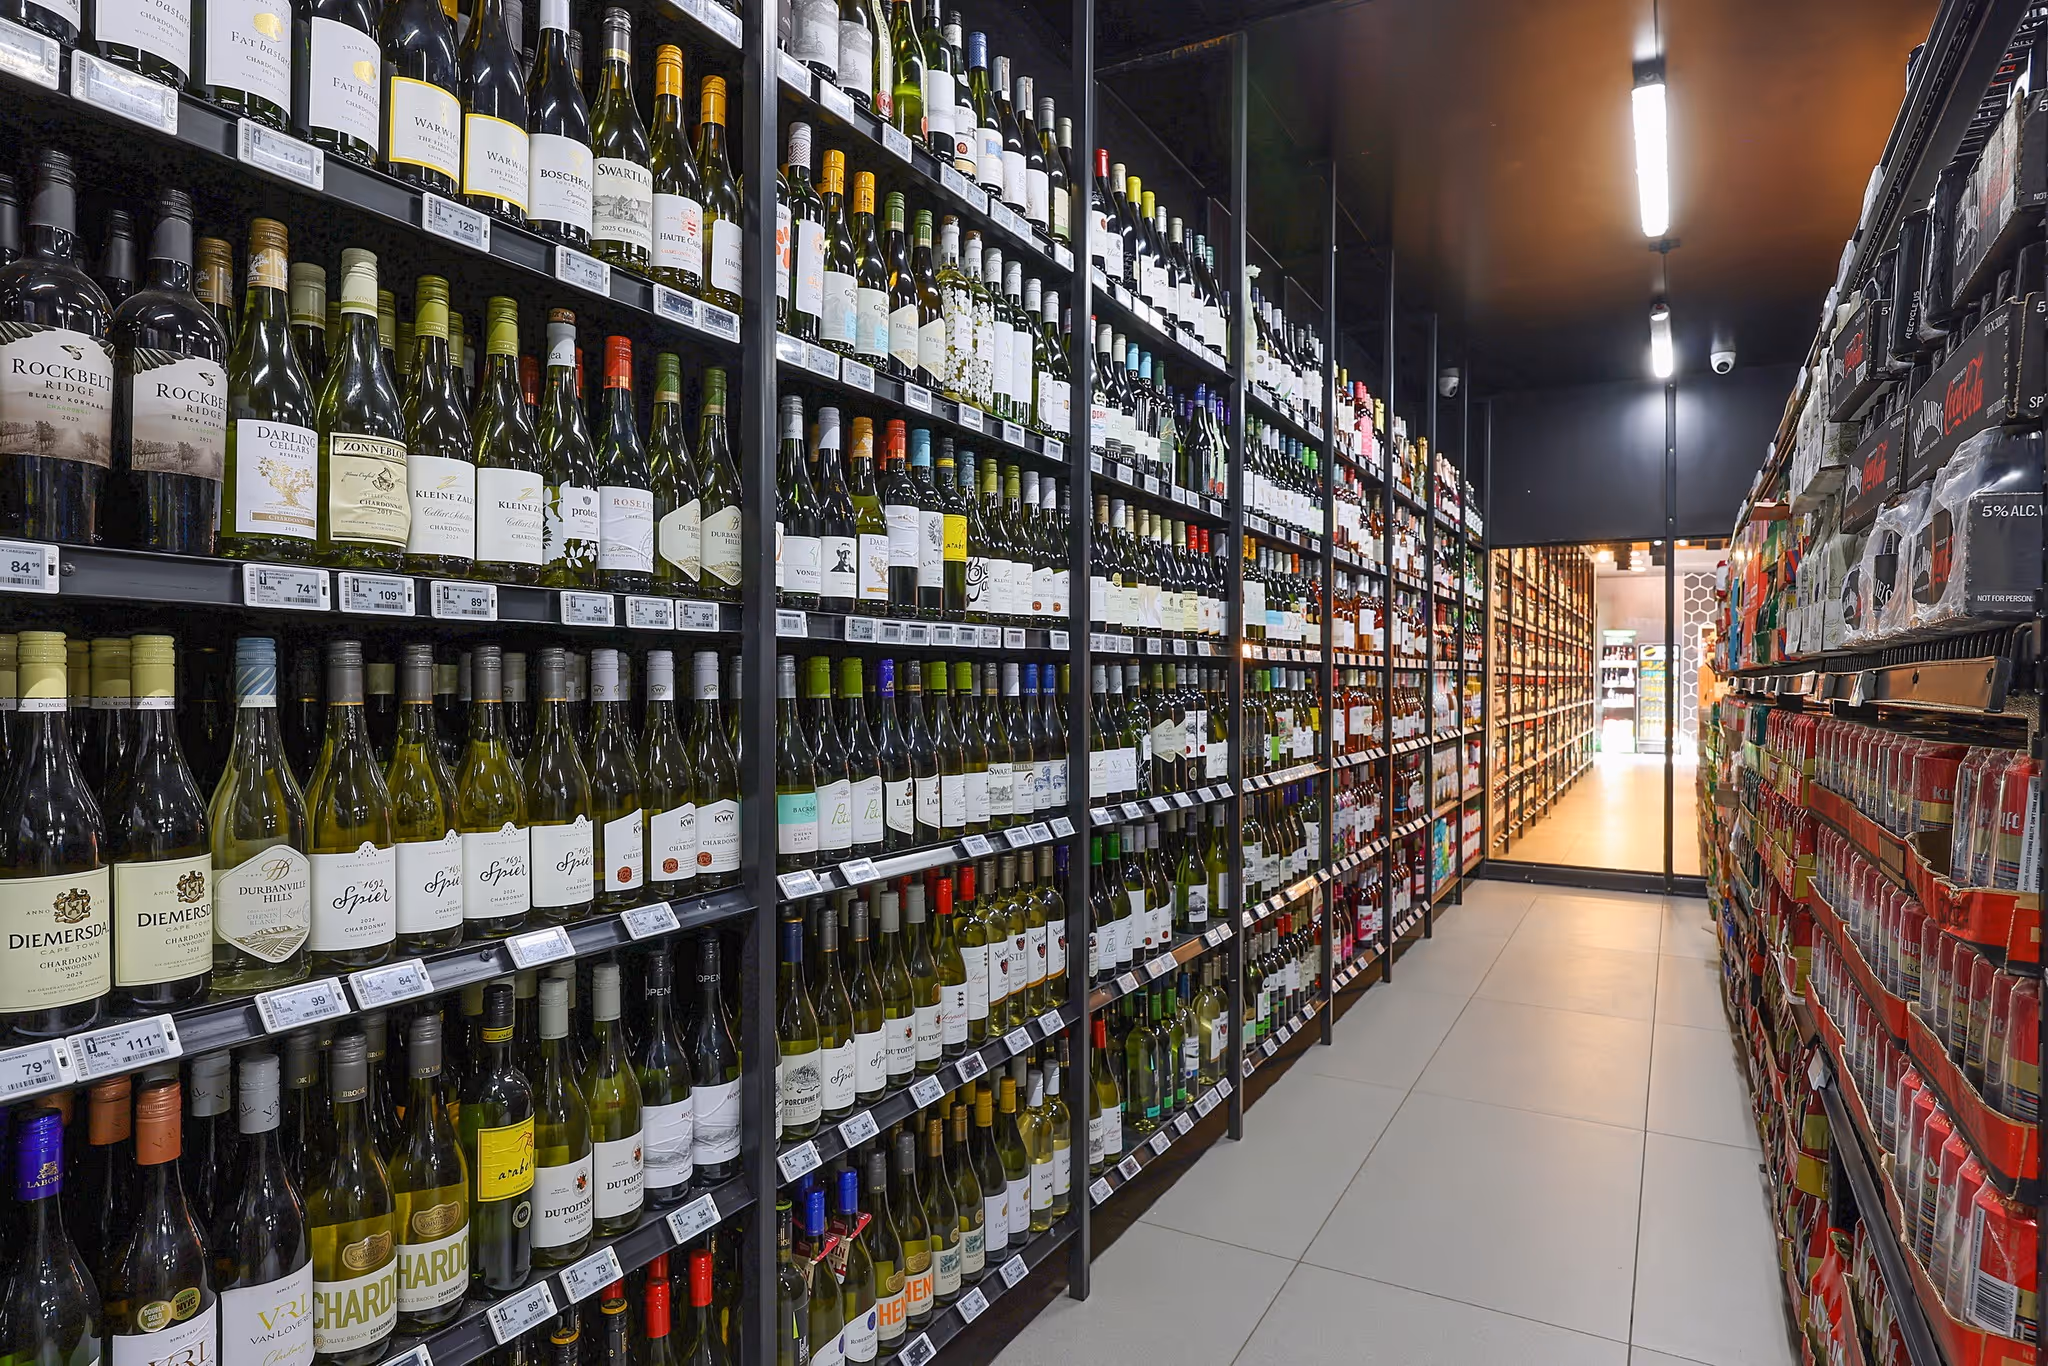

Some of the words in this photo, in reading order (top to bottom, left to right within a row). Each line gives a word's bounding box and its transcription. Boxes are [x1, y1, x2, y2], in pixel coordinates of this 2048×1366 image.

[231, 30, 256, 47] FAT
[332, 77, 355, 92] FAT
[660, 233, 686, 244] HAUTE
[1905, 302, 1919, 340] RECYCLE
[1912, 291, 1920, 302] US
[12, 358, 111, 392] ROCKBELT
[45, 380, 94, 397] RIDGE
[28, 392, 62, 401] BLACK
[186, 404, 222, 421] RIDGE
[171, 414, 200, 424] BLACK
[257, 426, 316, 449] DARLING
[269, 440, 310, 455] CELLARS
[415, 490, 455, 501] KLEINE
[498, 501, 532, 512] KLEINE
[1982, 506, 2008, 517] 5%
[2011, 505, 2037, 517] ALC.
[571, 507, 598, 519] protea
[714, 814, 734, 823] KWV
[480, 860, 527, 886] Spier
[239, 880, 306, 896] DURBANVILLE
[362, 879, 384, 892] 1692
[263, 892, 292, 903] HILLS
[332, 886, 392, 914] Spier
[25, 908, 50, 916] ANNO
[247, 913, 279, 921] CHENIN
[166, 925, 190, 933] CAPE
[345, 922, 387, 933] CHARDONNAY
[40, 947, 70, 956] CAPE
[76, 940, 100, 950] TOWN
[40, 952, 101, 969] CHARDONNAY
[54, 961, 92, 973] UNWOODED
[66, 971, 83, 979] 2025
[785, 1095, 815, 1106] PORCUPINE
[144, 1305, 165, 1316] DOUBLE
[148, 1312, 163, 1322] GOLD
[250, 1333, 275, 1345] VAN
